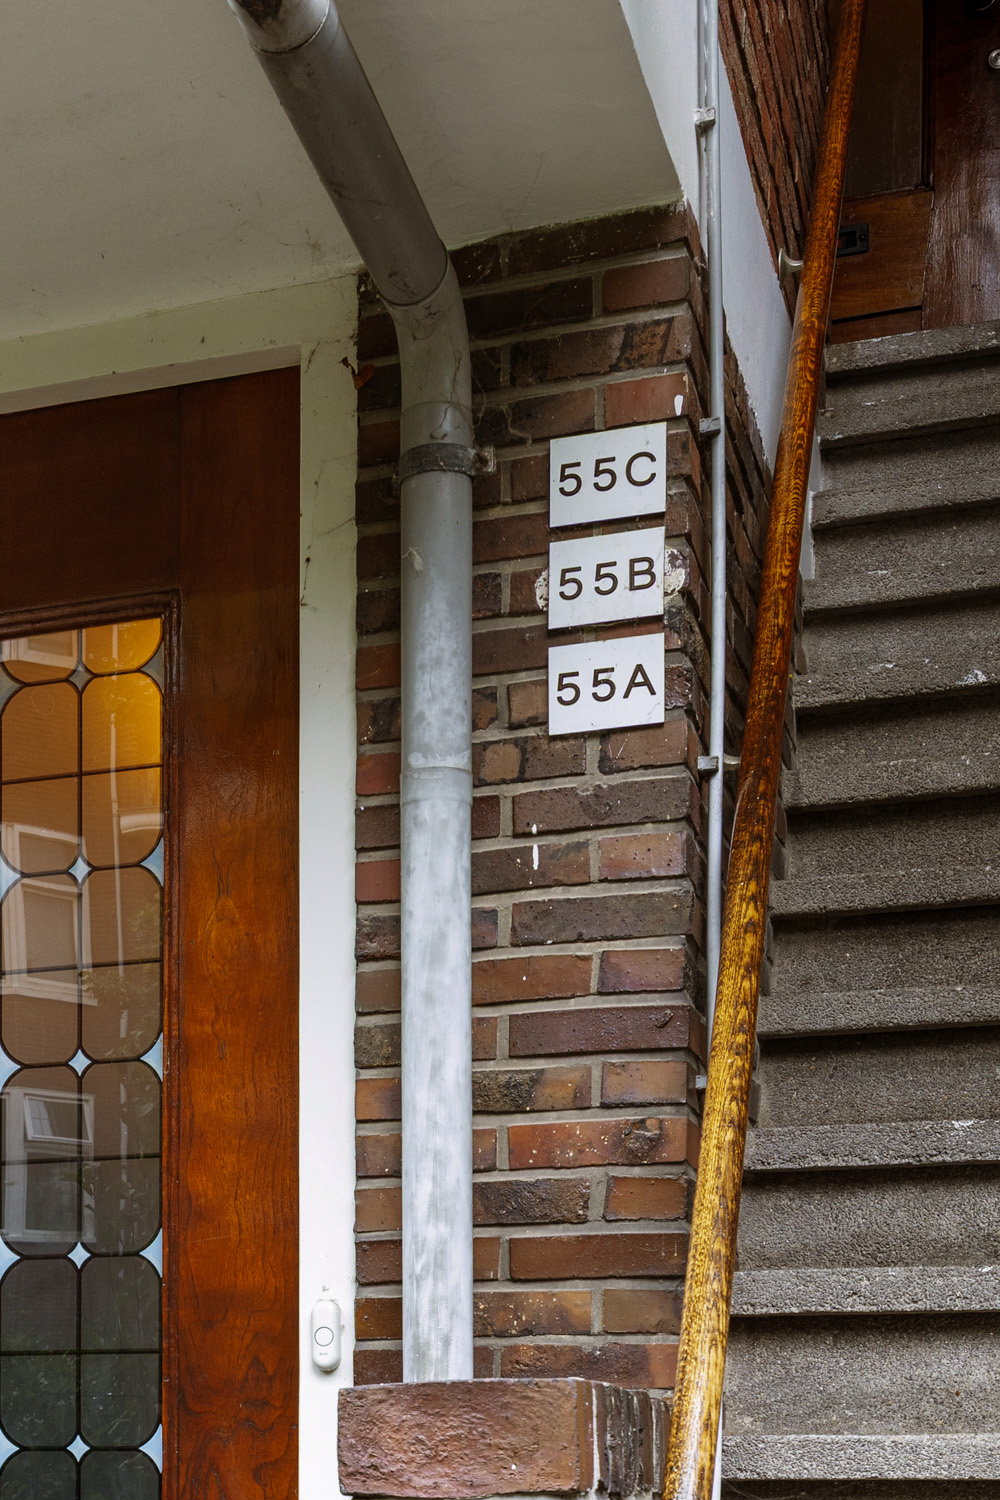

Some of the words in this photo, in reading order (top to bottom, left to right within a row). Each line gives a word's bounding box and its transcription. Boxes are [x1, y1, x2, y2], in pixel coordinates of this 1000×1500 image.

[558, 451, 657, 497] 55C
[558, 556, 657, 600] 55B
[556, 663, 656, 706] 55A
